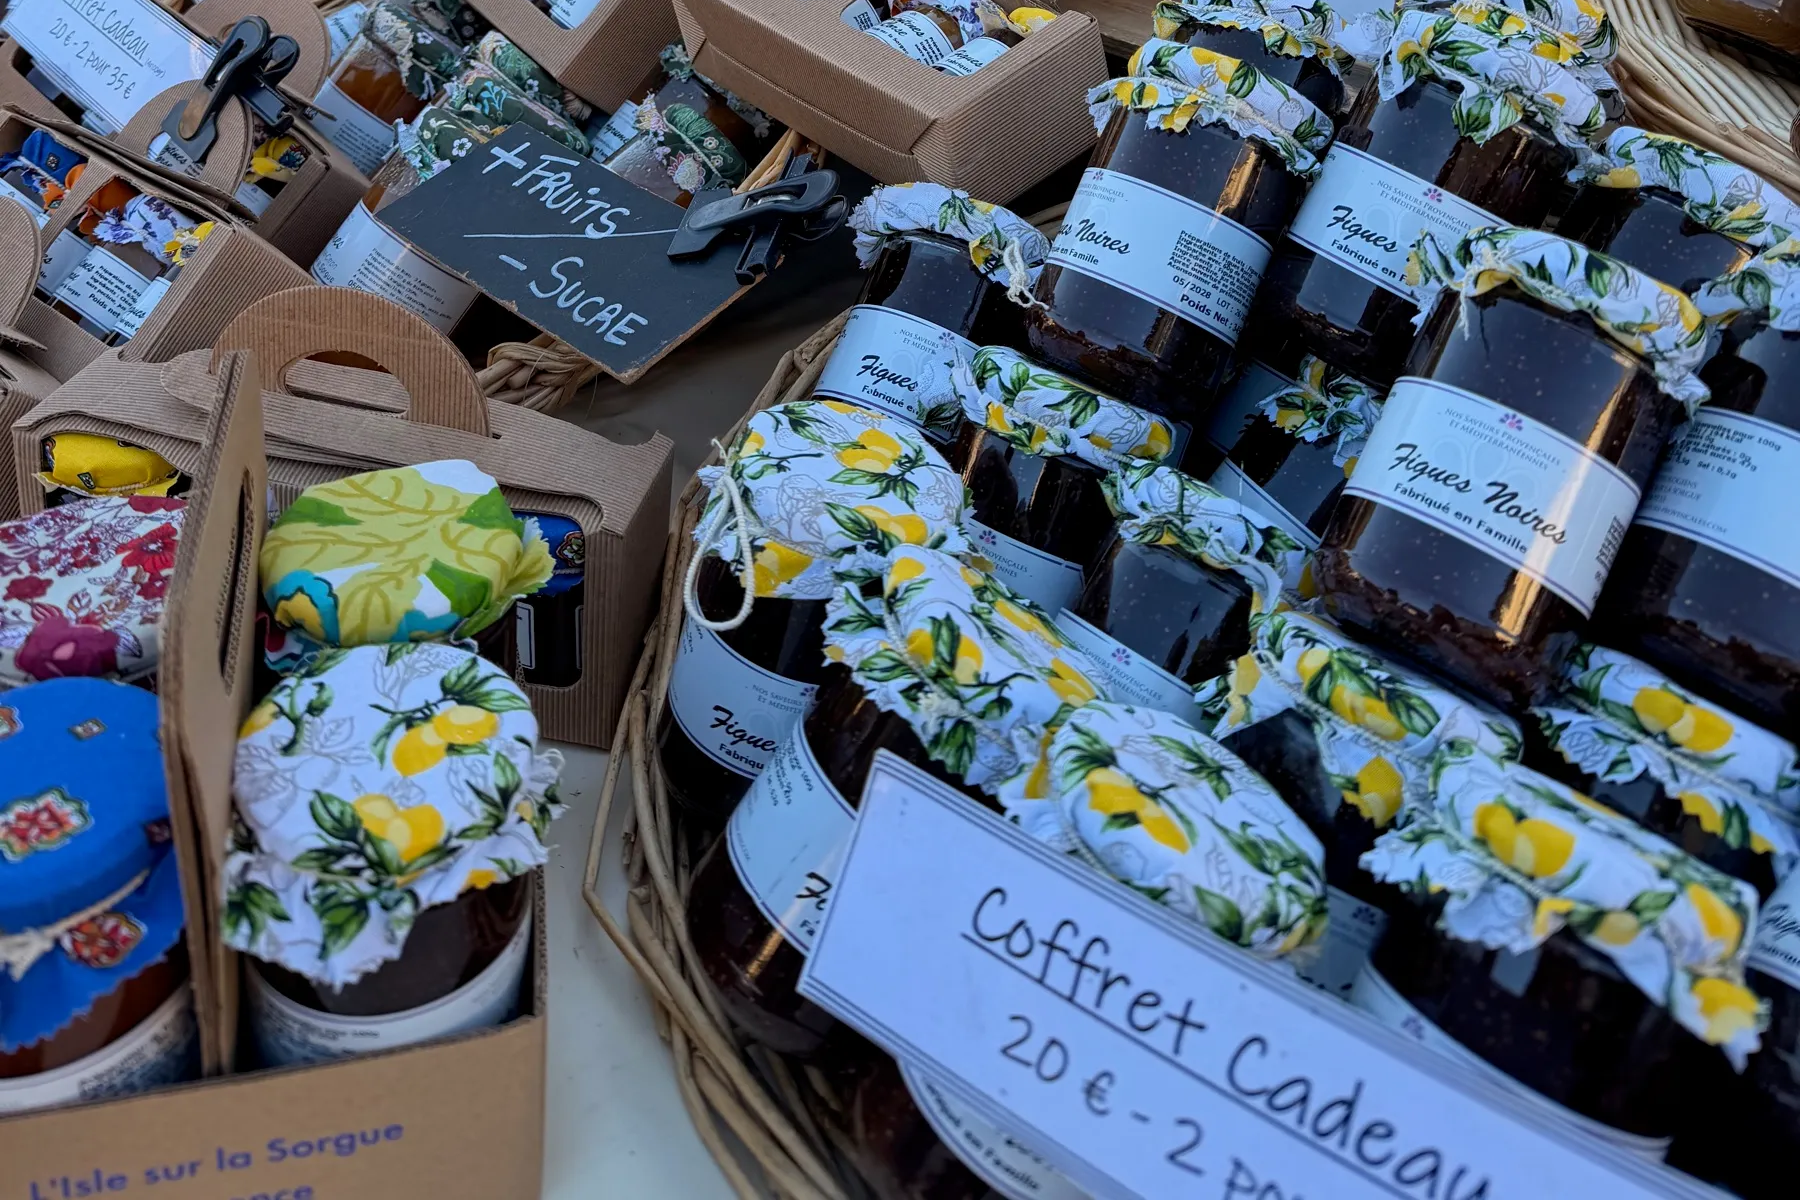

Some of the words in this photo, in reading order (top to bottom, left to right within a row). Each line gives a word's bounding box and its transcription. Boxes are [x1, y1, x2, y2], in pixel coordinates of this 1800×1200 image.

[102, 10, 149, 60] Cadeau
[49, 17, 68, 39] 20
[64, 30, 76, 46] €
[75, 40, 89, 60] 2
[83, 51, 110, 76] pour
[106, 66, 128, 91] 35
[123, 81, 136, 99] €
[512, 154, 631, 240] FRUITS
[1377, 180, 1393, 192] NOS
[1393, 187, 1423, 206] SAVEURS
[1423, 202, 1473, 230] PROVENÇALES
[1380, 190, 1389, 199] ET
[1390, 194, 1461, 235] MÉDITERRANÉENNES
[1075, 219, 1130, 254] Noires
[1327, 205, 1398, 253] Figues
[319, 263, 335, 283] Sorgue
[1060, 246, 1068, 255] en
[1069, 248, 1099, 265] Famille
[1331, 239, 1379, 269] Fabriqué
[1382, 265, 1397, 279] en
[88, 292, 109, 311] Poids
[107, 307, 121, 319] net
[1173, 275, 1211, 299] 05/2028
[1216, 298, 1230, 310] LOT
[1180, 294, 1211, 316] Poids
[1213, 311, 1229, 326] Net
[900, 328, 913, 338] NOS
[914, 333, 939, 349] SAVEURS
[902, 337, 912, 345] ET
[856, 354, 919, 392] Figues
[862, 385, 905, 409] Fabriqué
[1445, 408, 1463, 420] NOS
[1463, 415, 1501, 436] SAVEURS
[1501, 431, 1561, 466] PROVENÇALES
[1388, 443, 1472, 493] Figues
[1483, 480, 1567, 546] Noires
[1394, 483, 1451, 514] Fabriqué
[1454, 511, 1473, 525] en
[1476, 520, 1528, 554] Famille
[752, 684, 769, 698] NOS
[758, 695, 767, 703] ET
[973, 888, 1205, 1056] Coffret
[1227, 1036, 1492, 1200] Cadeau
[1000, 1015, 1068, 1083] 20
[1083, 1072, 1117, 1117] €
[1166, 1119, 1205, 1178] 2
[29, 1168, 129, 1200] L'Isle
[144, 1160, 202, 1187] sur
[216, 1146, 253, 1172] la
[266, 1121, 406, 1163] Sorgue
